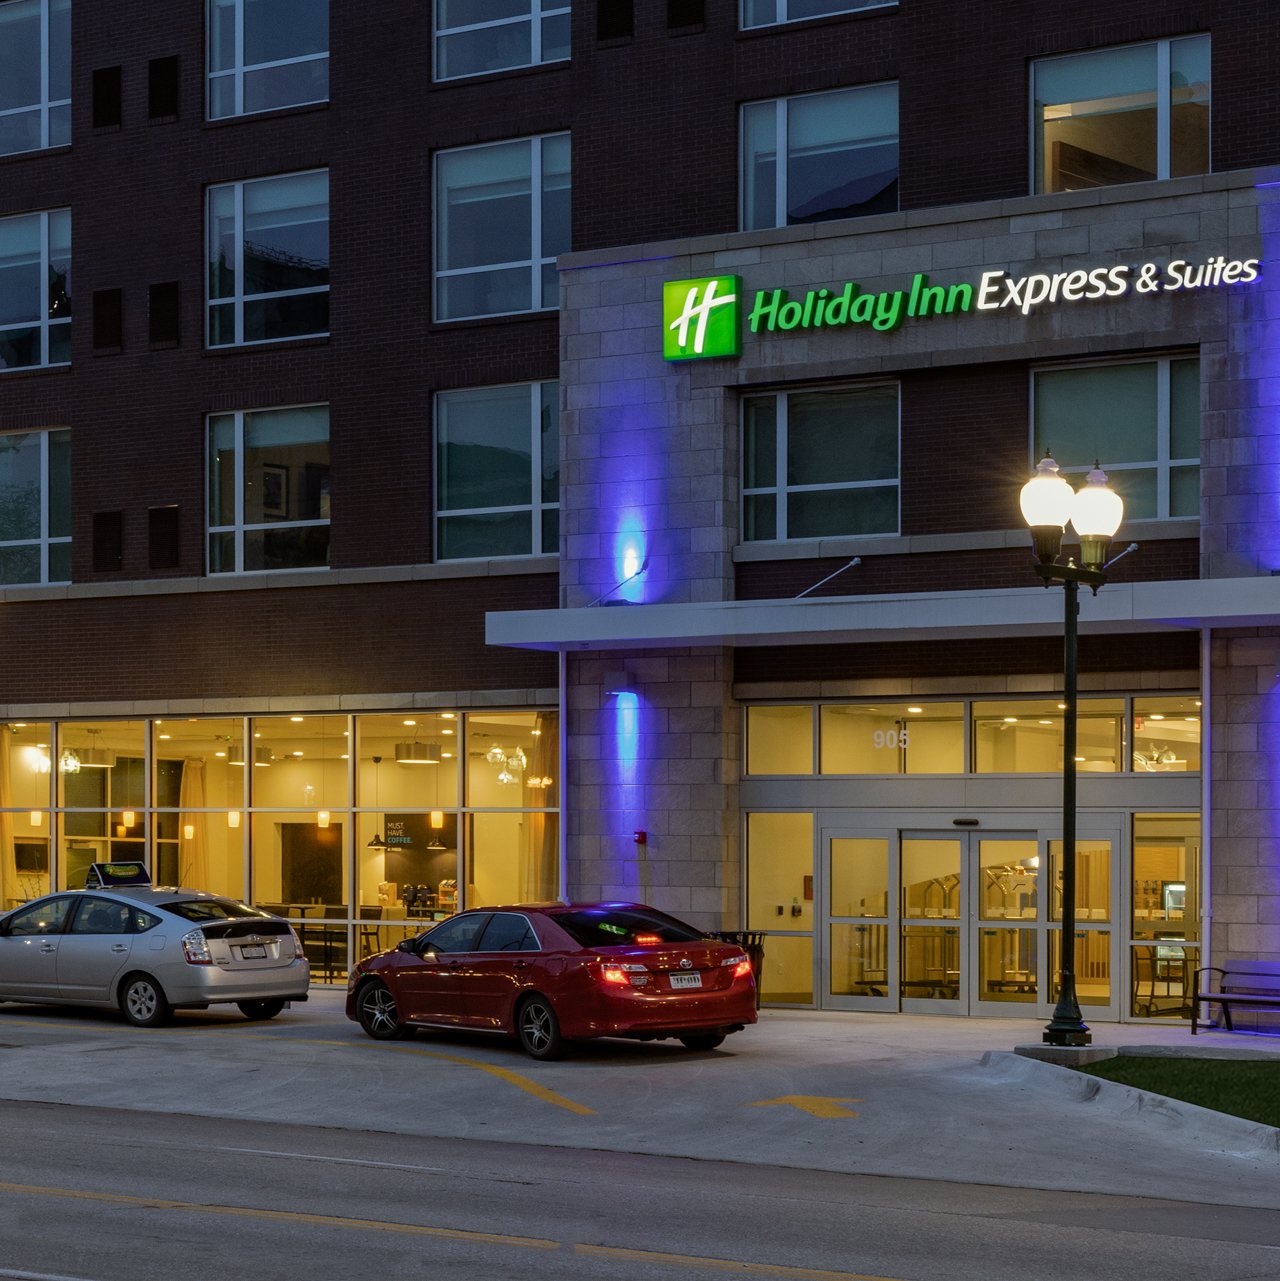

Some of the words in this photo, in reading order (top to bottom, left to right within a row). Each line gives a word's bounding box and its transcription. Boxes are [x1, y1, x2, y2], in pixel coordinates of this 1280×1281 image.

[748, 282, 909, 333] Holiday
[908, 273, 972, 317] Inn
[976, 265, 1128, 315] Express
[1135, 262, 1159, 292] &
[1162, 256, 1261, 291] Suites
[873, 730, 910, 749] 905
